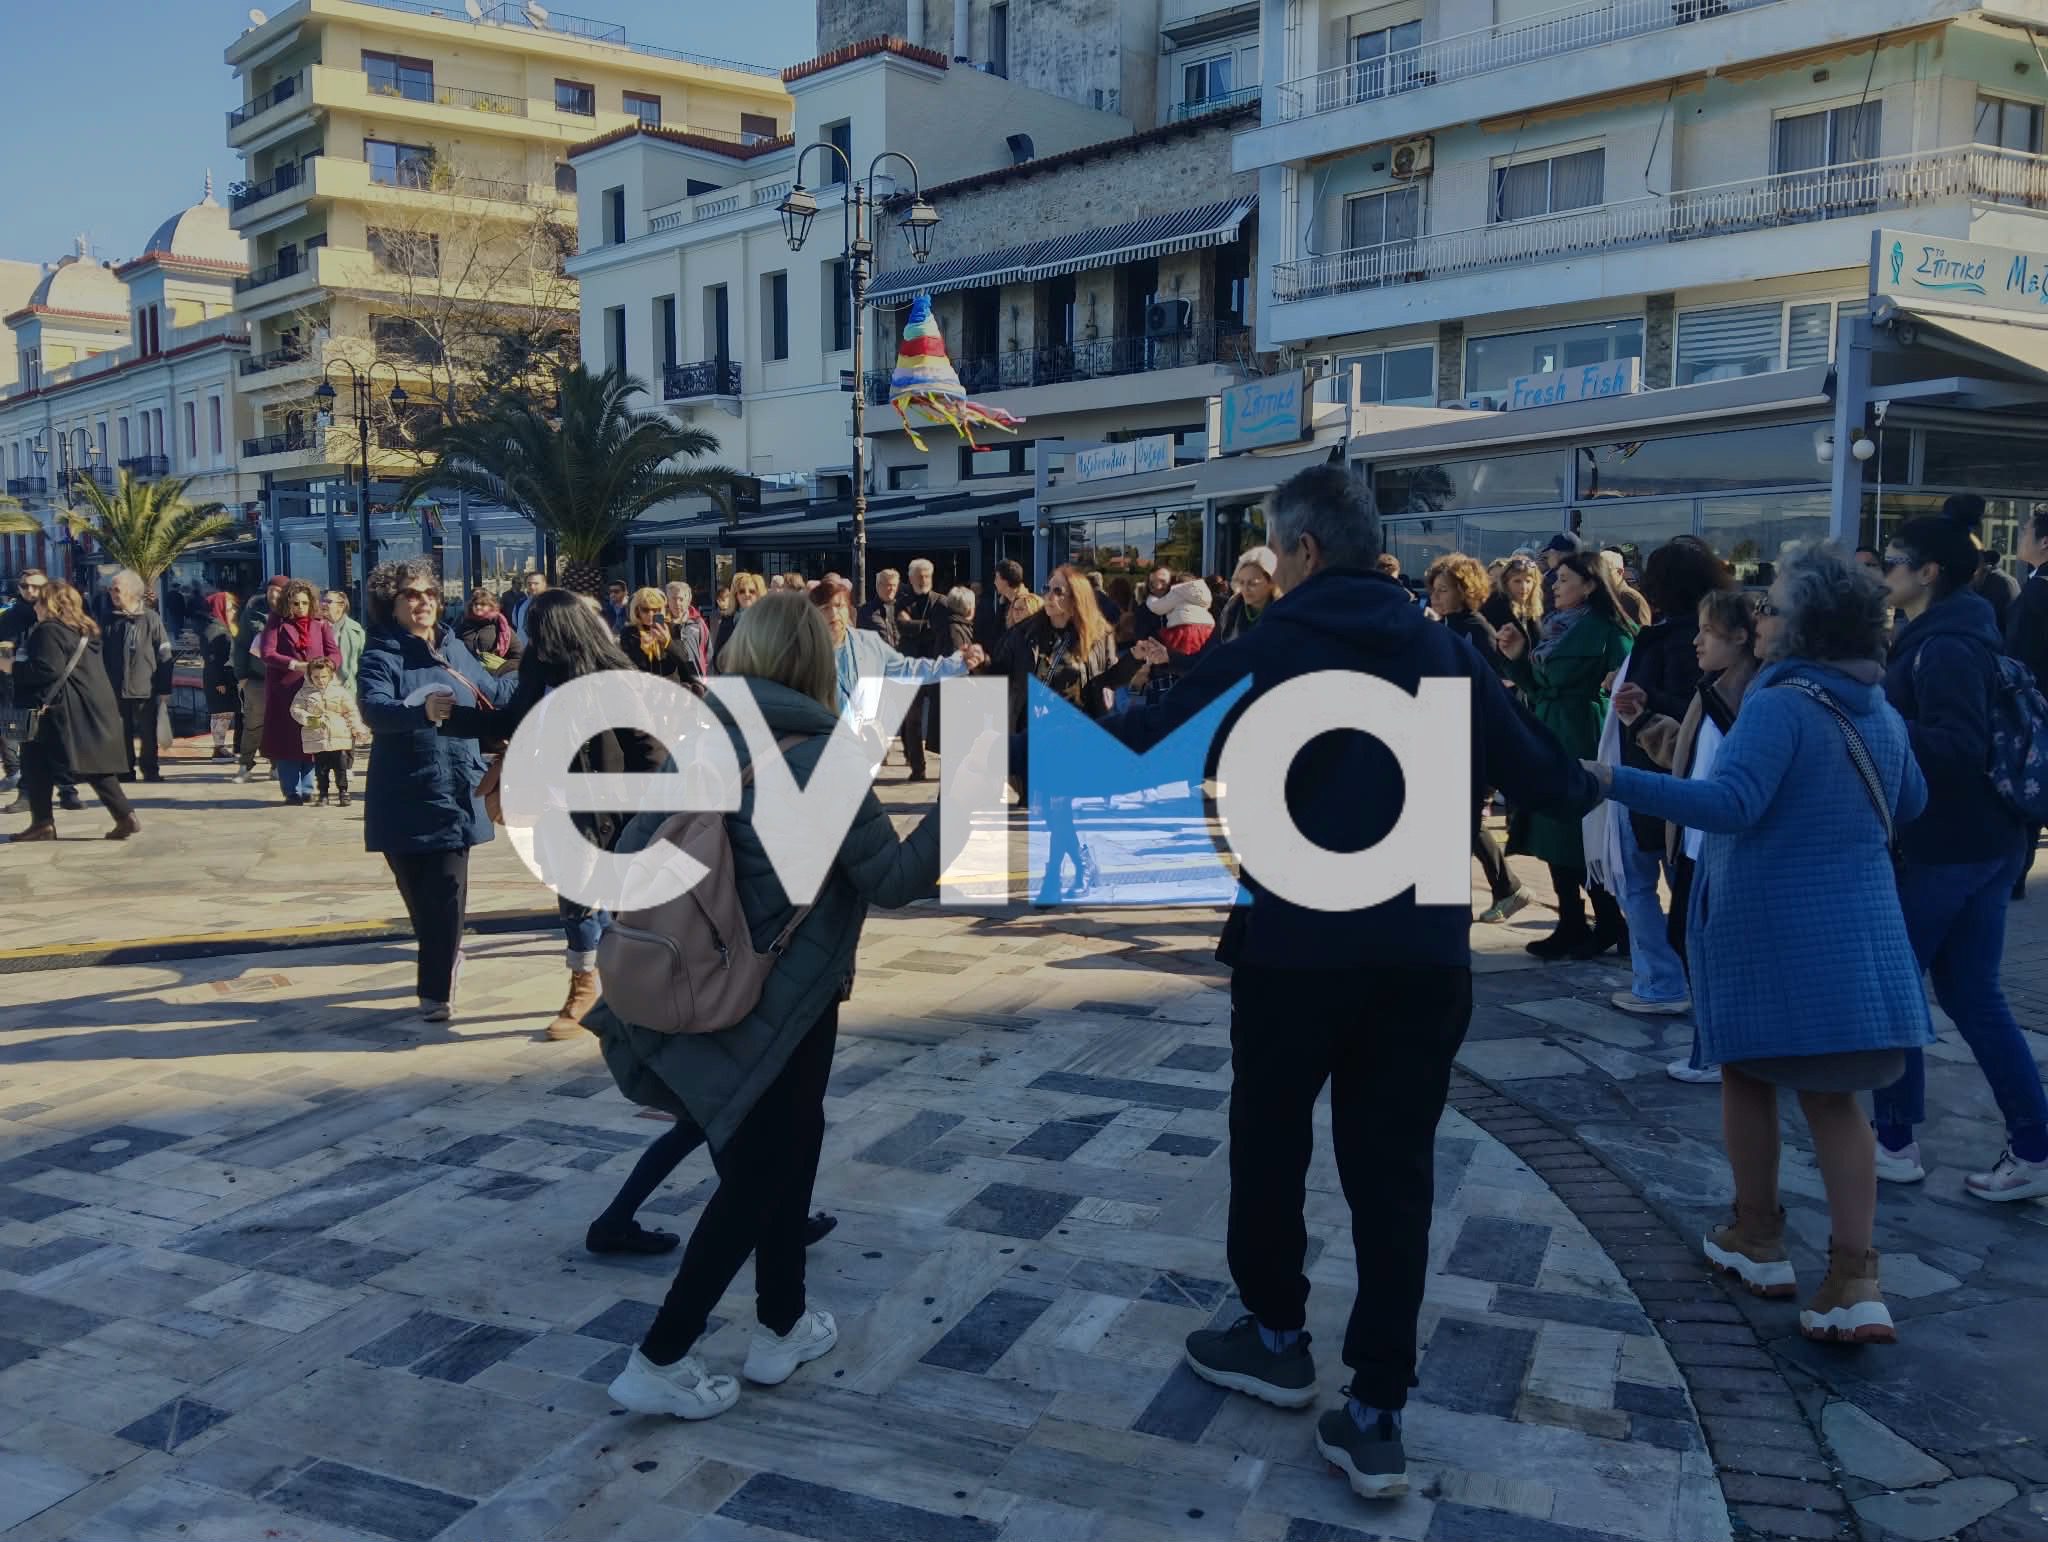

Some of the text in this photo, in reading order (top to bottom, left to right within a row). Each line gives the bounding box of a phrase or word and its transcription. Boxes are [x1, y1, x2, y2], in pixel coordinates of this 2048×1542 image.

[1916, 246, 1986, 280] Σπιτικό
[1513, 362, 1625, 408] Fresh Fish
